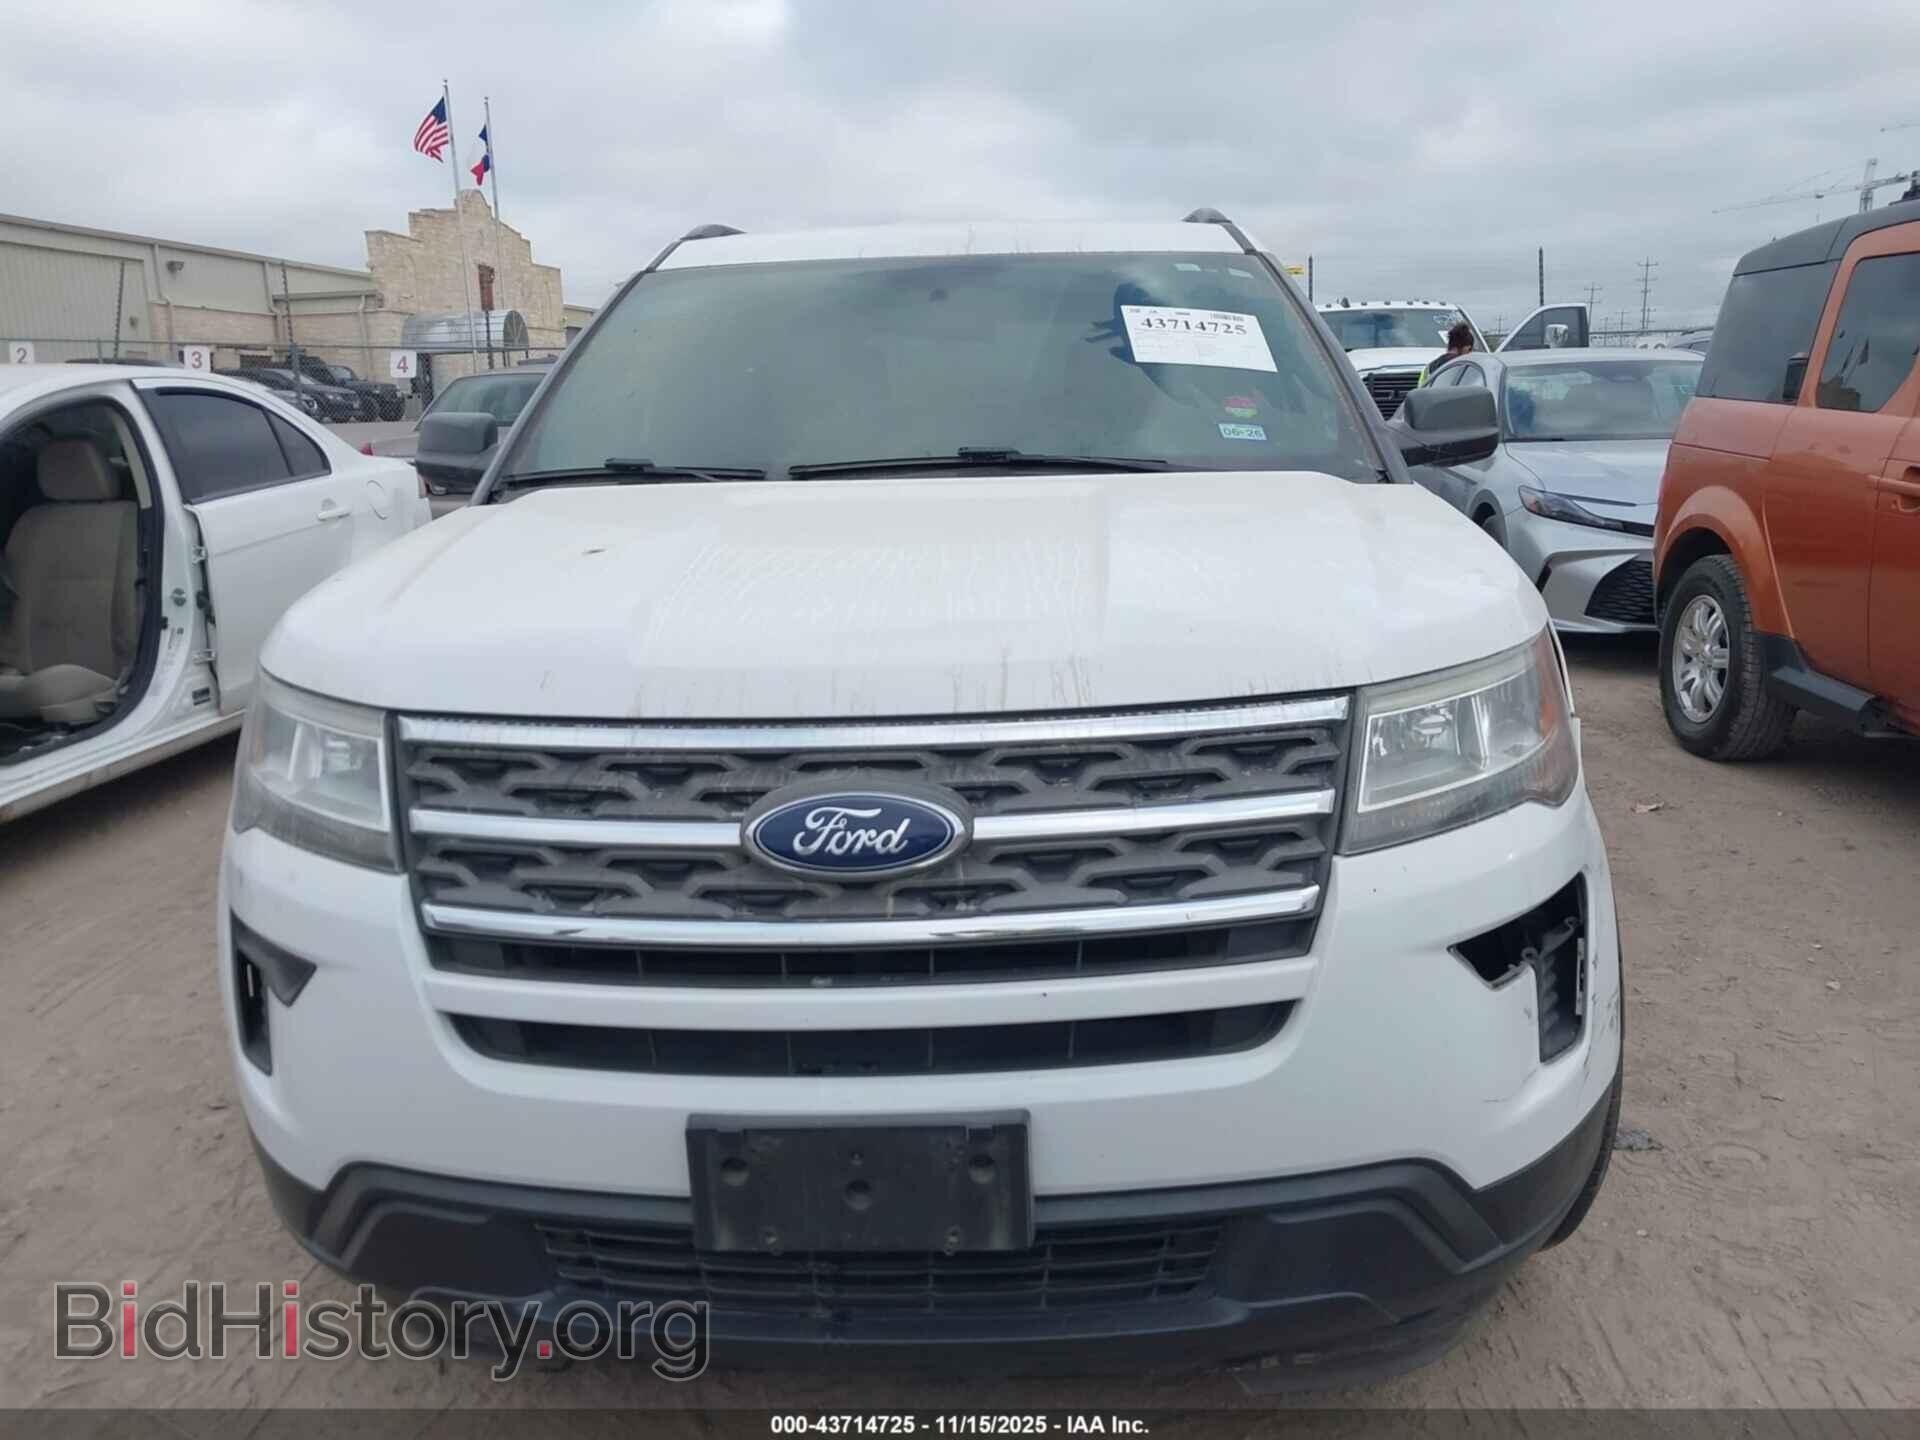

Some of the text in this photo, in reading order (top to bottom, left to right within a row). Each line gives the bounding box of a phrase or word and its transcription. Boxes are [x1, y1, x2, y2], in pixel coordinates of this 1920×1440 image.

[1141, 318, 1247, 335] 43714725
[16, 347, 28, 364] 2
[191, 351, 202, 368] 3
[396, 356, 409, 373] 4
[793, 807, 910, 855] Ford
